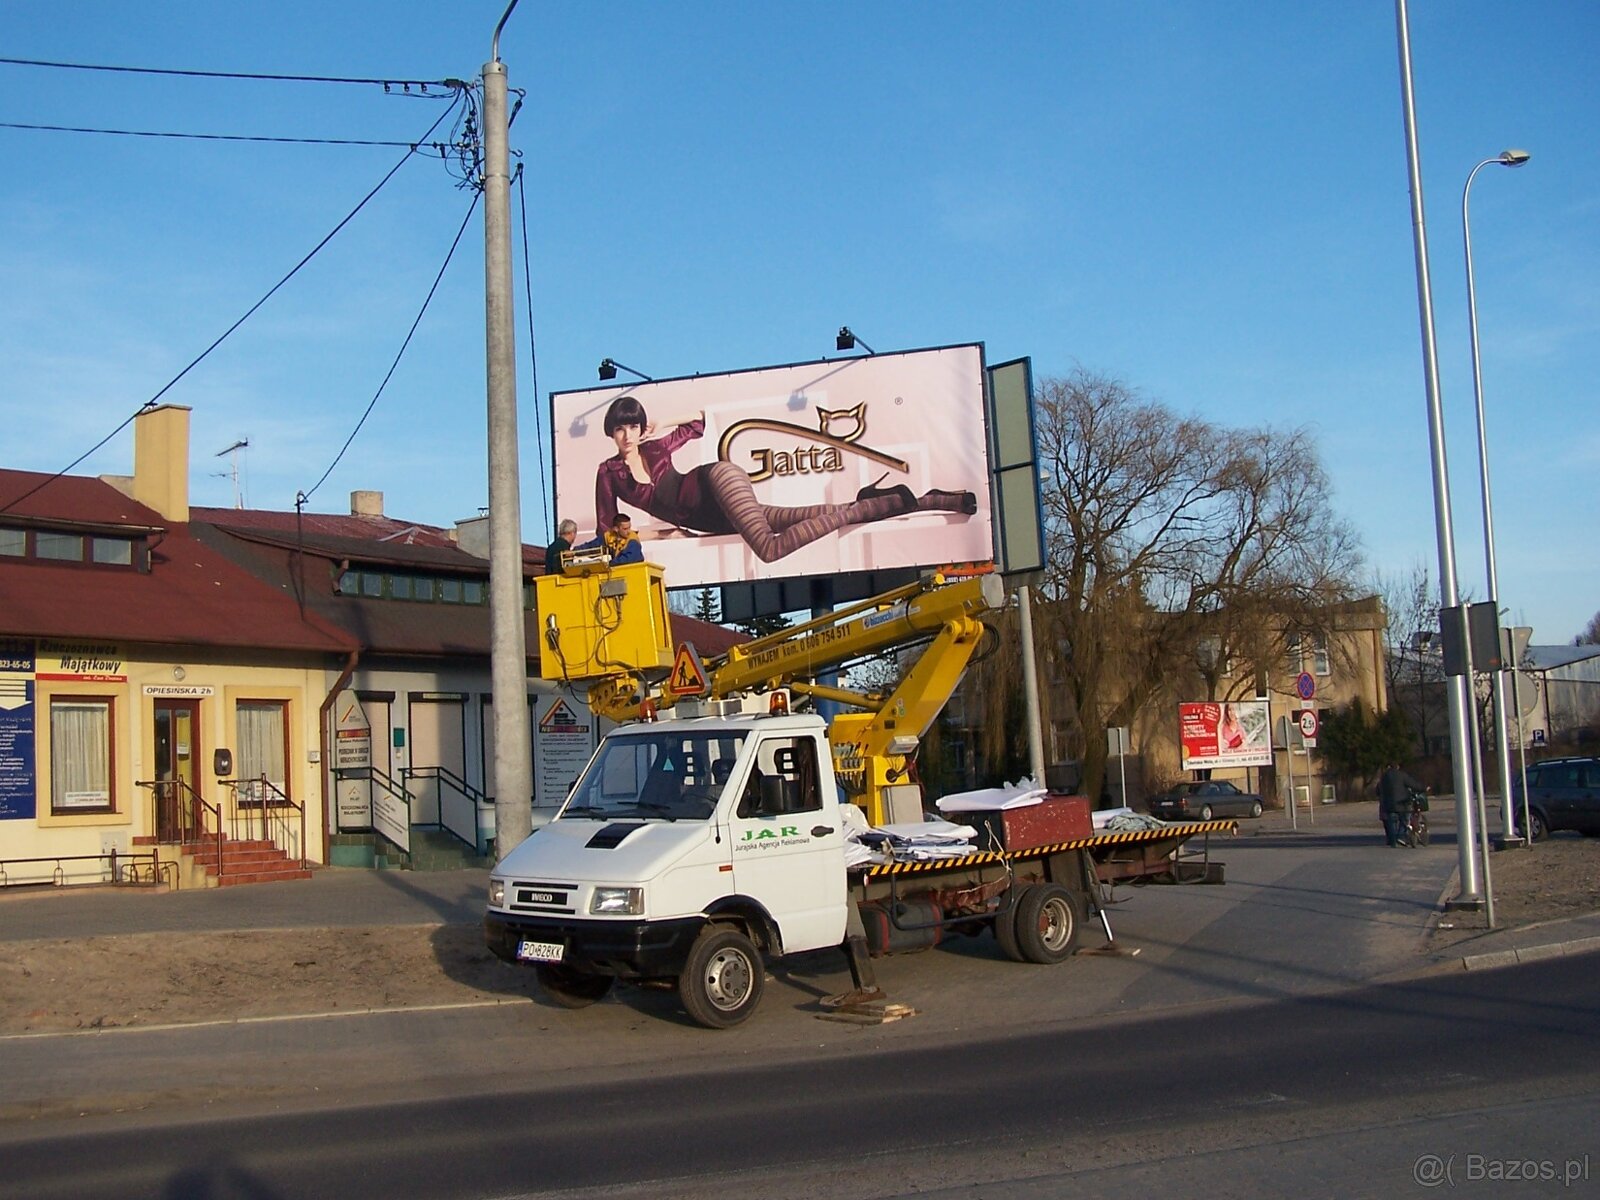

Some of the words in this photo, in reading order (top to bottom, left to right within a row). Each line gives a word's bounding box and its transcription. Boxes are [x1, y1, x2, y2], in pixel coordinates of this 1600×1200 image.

[748, 648, 779, 669] WYNAJEM
[821, 629, 835, 644] 754
[837, 623, 850, 639] 511
[60, 656, 121, 674] Majątkowy
[741, 826, 802, 841] JAR
[758, 841, 780, 850] Agencja
[781, 838, 810, 847] Reklamowa
[531, 892, 553, 902] IVECO
